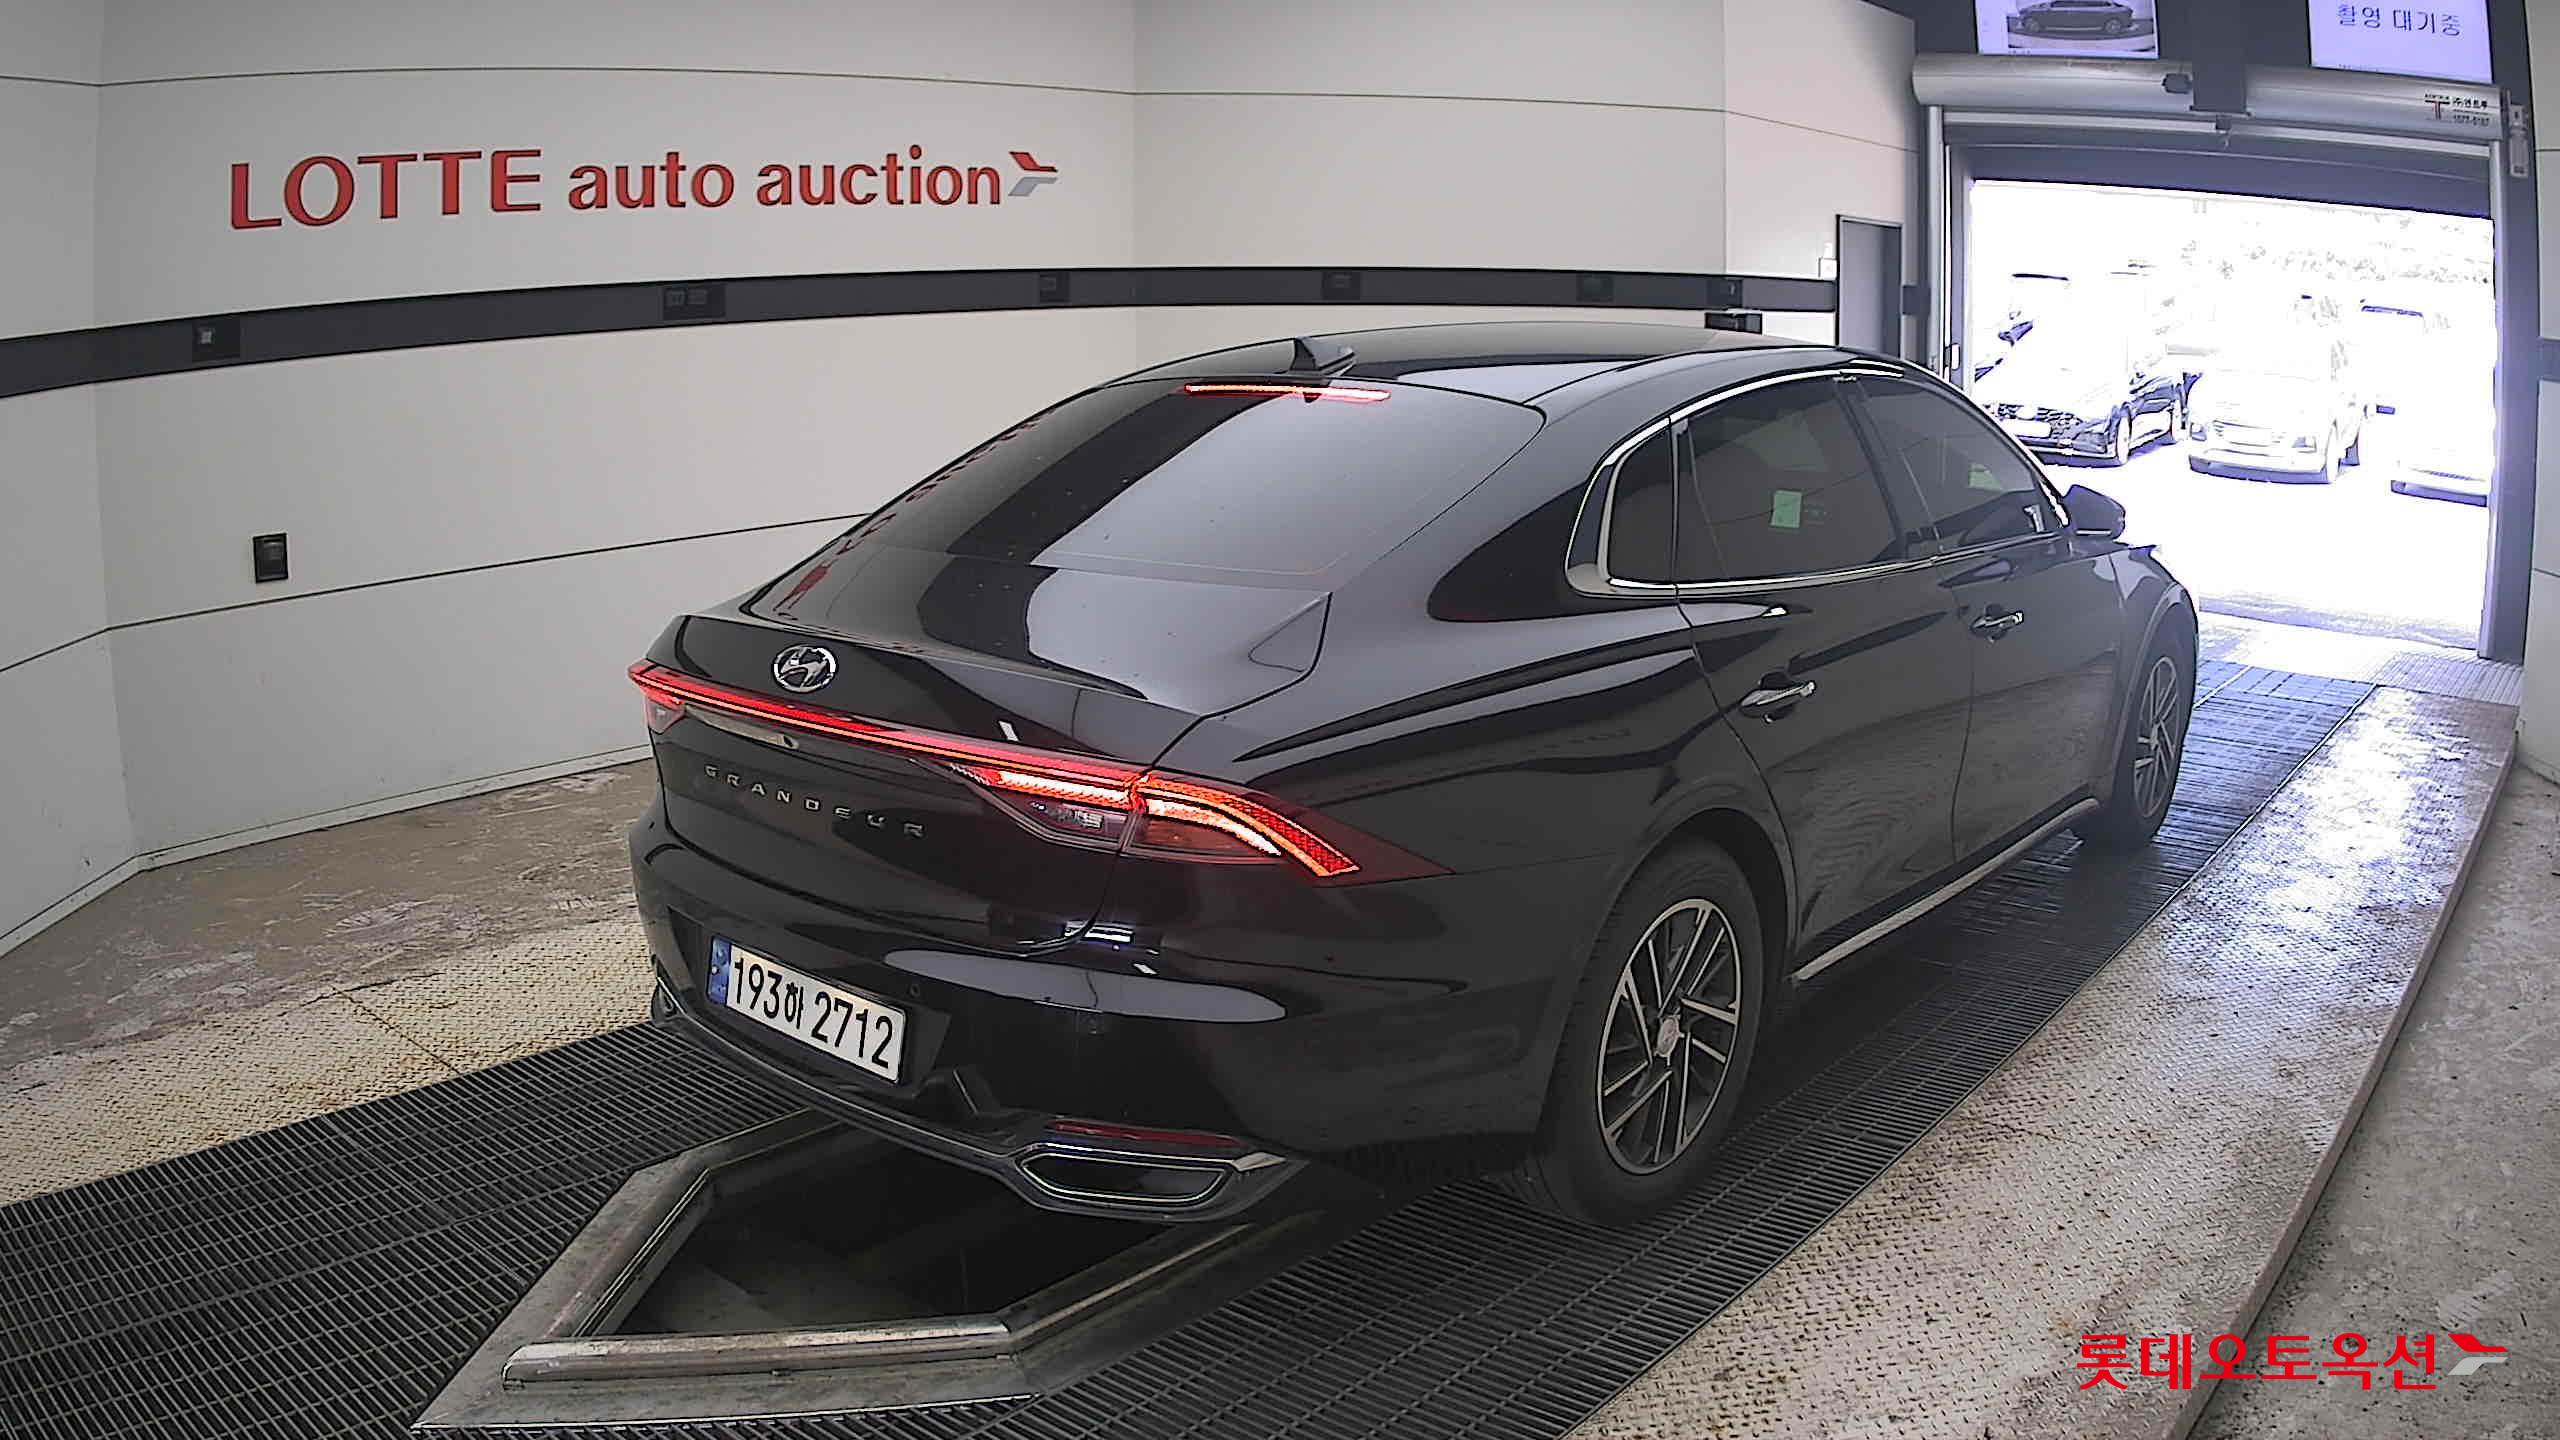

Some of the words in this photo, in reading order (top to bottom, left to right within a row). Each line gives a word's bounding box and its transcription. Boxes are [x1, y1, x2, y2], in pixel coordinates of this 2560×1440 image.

[2392, 10, 2461, 37] 대기중
[231, 149, 539, 229] LOTTE
[568, 151, 734, 210] auto
[756, 144, 1002, 206] auction
[703, 763, 927, 839] GRANDEUR
[733, 957, 805, 1030] 193하
[810, 991, 894, 1069] 2712
